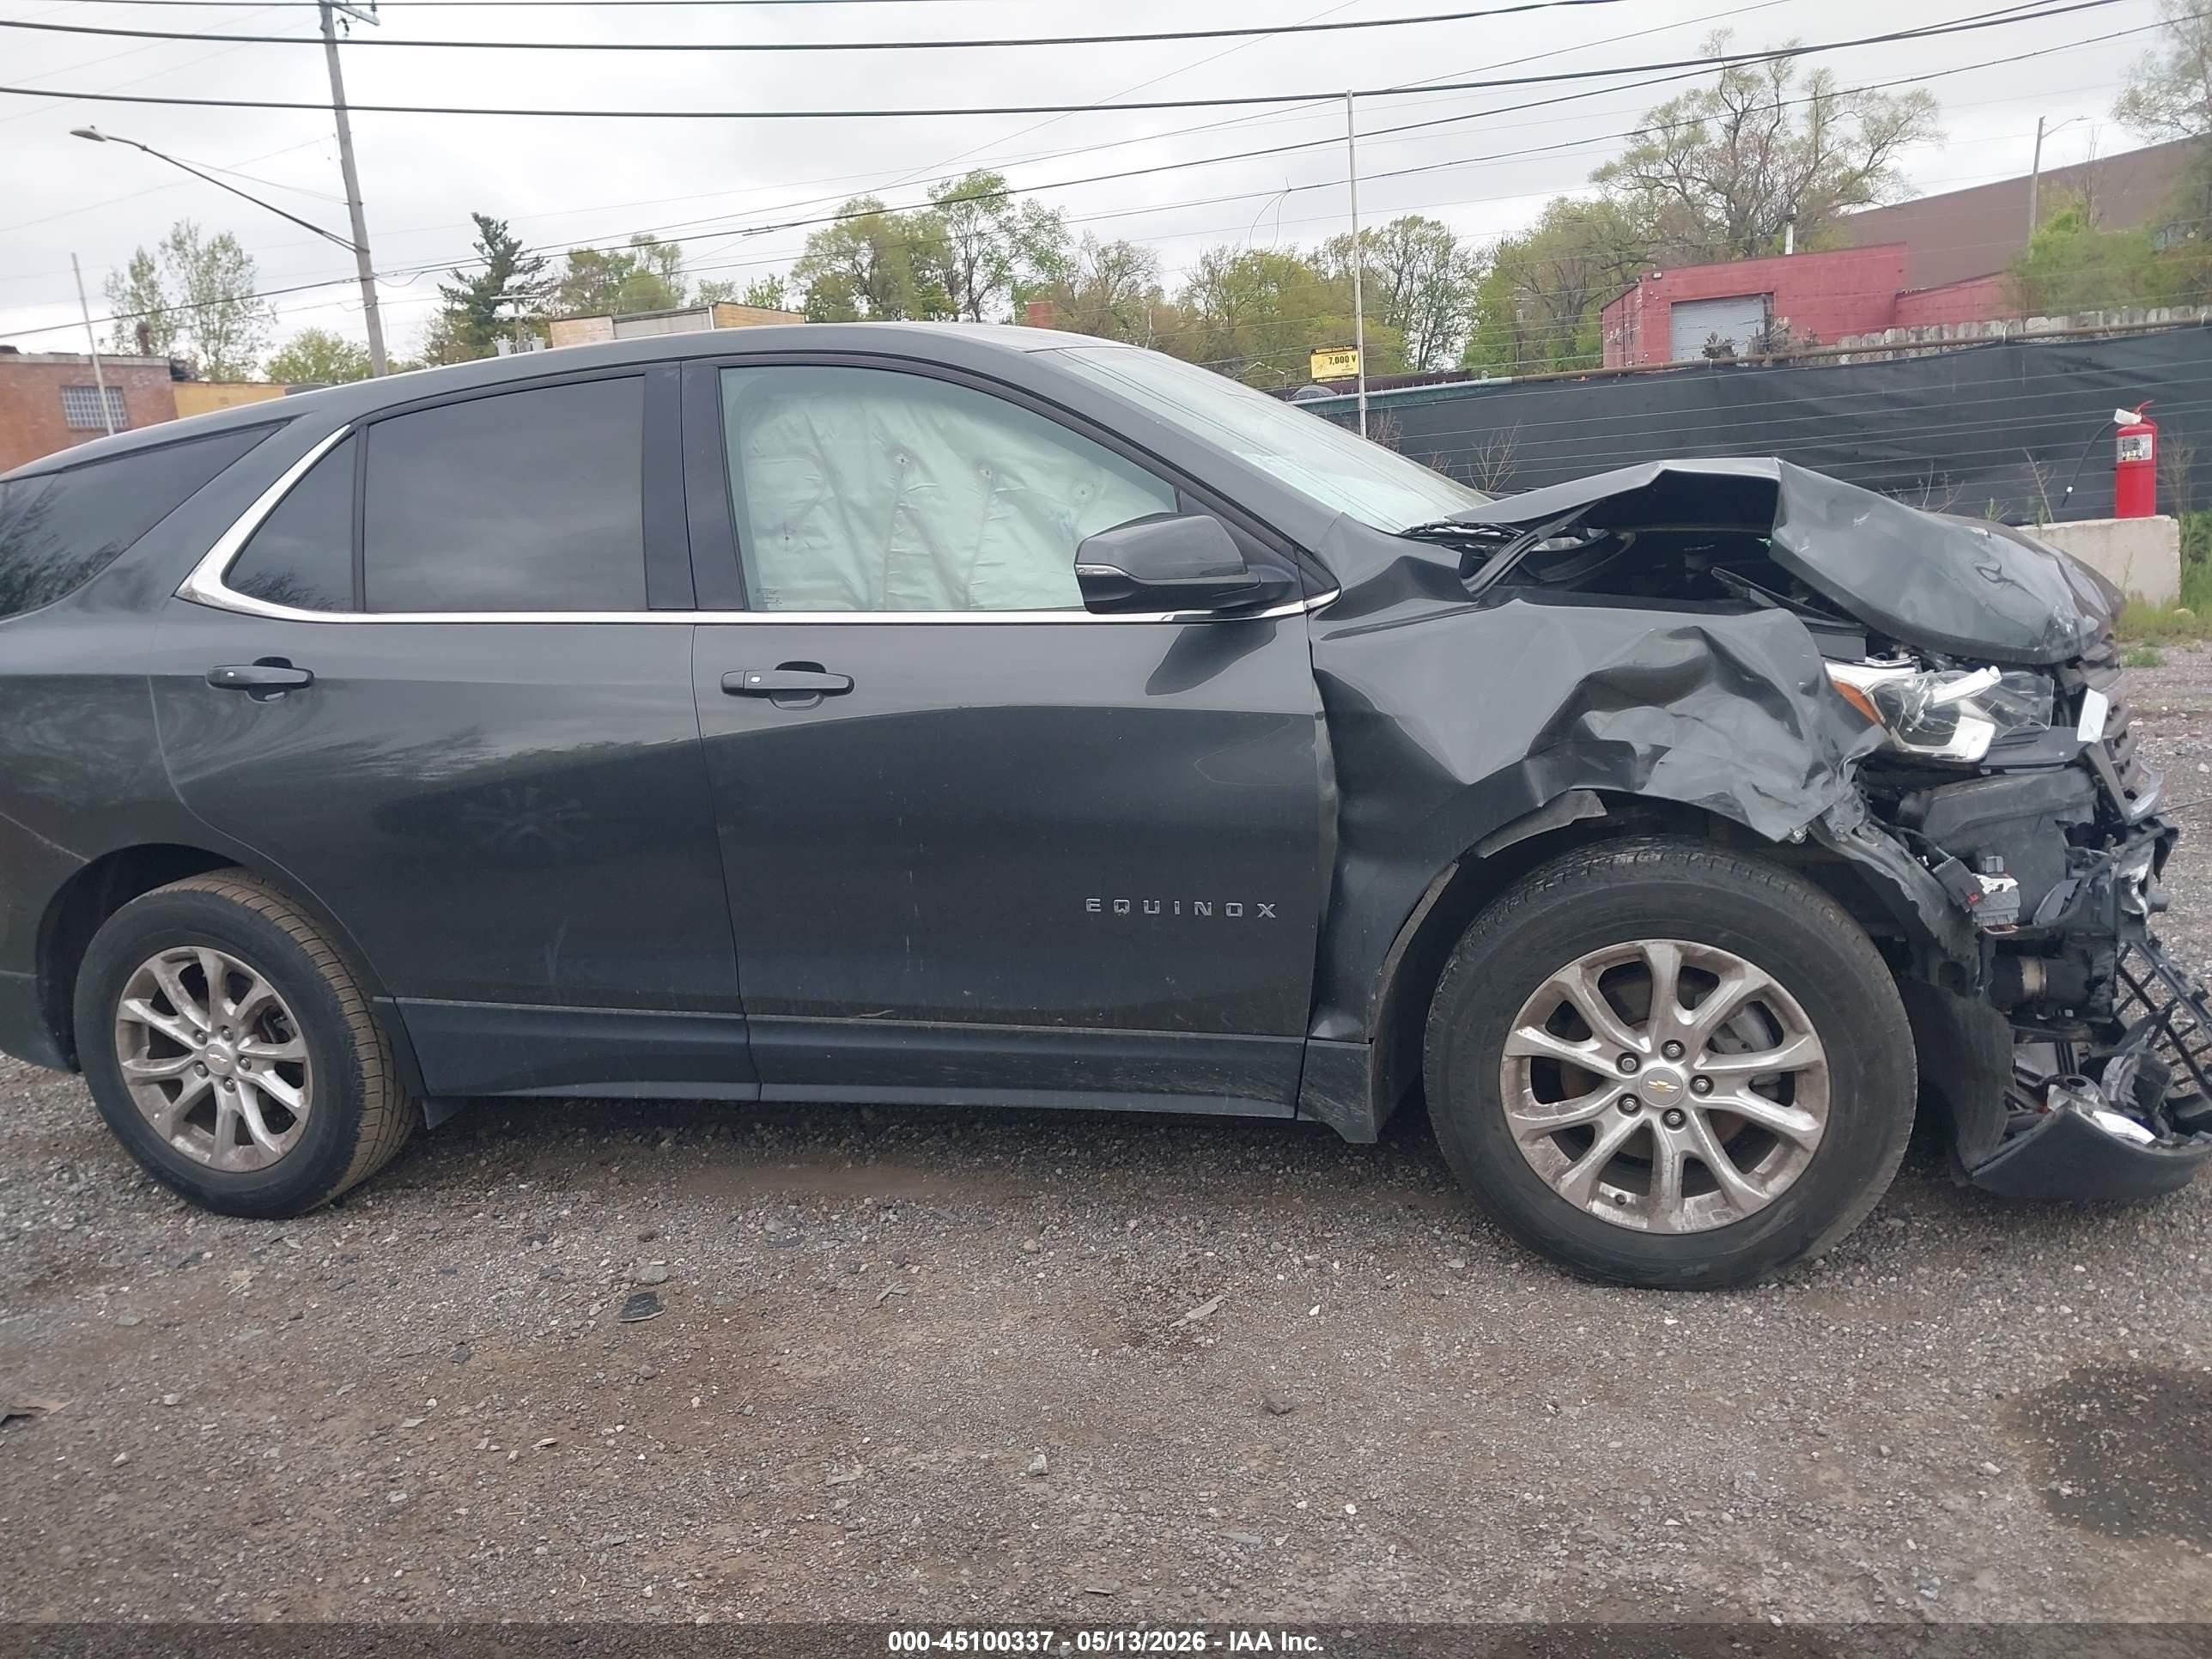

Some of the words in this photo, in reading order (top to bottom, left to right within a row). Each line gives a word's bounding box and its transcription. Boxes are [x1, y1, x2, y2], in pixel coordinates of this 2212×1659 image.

[1328, 355, 1350, 366] 7,000
[1351, 354, 1357, 362] V
[1085, 897, 1277, 919] EQUINOX
